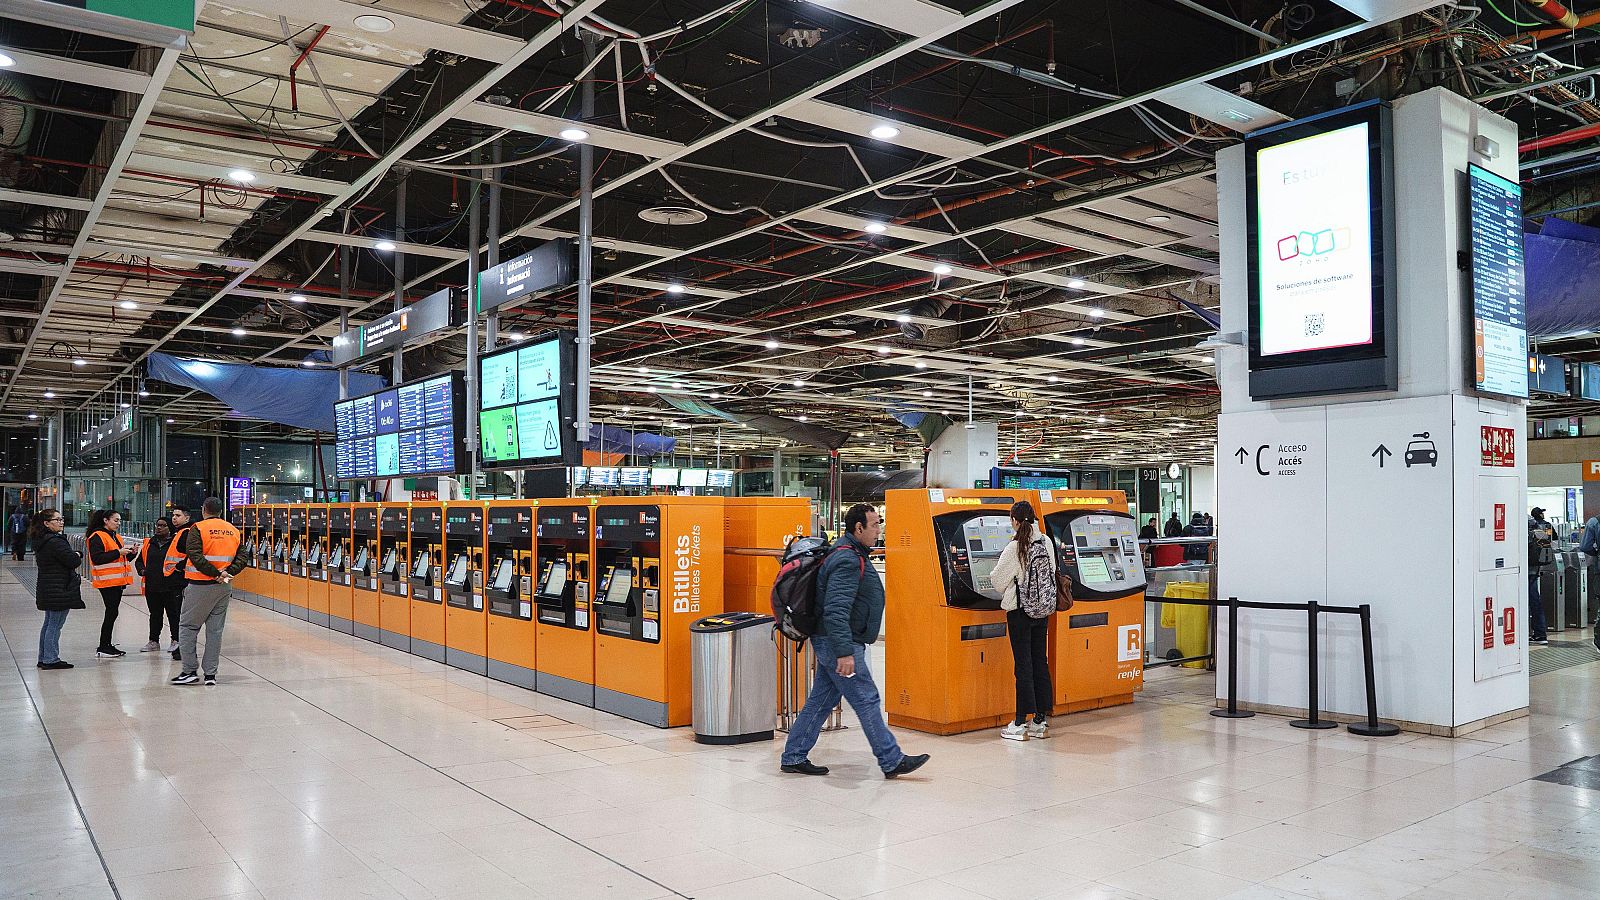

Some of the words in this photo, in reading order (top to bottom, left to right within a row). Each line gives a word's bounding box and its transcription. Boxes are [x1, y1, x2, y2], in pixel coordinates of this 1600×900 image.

[1276, 281, 1312, 291] Soluciones
[1313, 277, 1322, 285] de
[1323, 273, 1354, 283] software
[1256, 444, 1270, 476] C
[1278, 444, 1307, 453] Acceso
[1278, 456, 1302, 466] Accés
[690, 524, 701, 567] Tickets
[673, 535, 690, 613] Bitllets
[690, 569, 700, 613] Billetes
[1128, 629, 1140, 651] R
[1117, 666, 1141, 681] renfe
